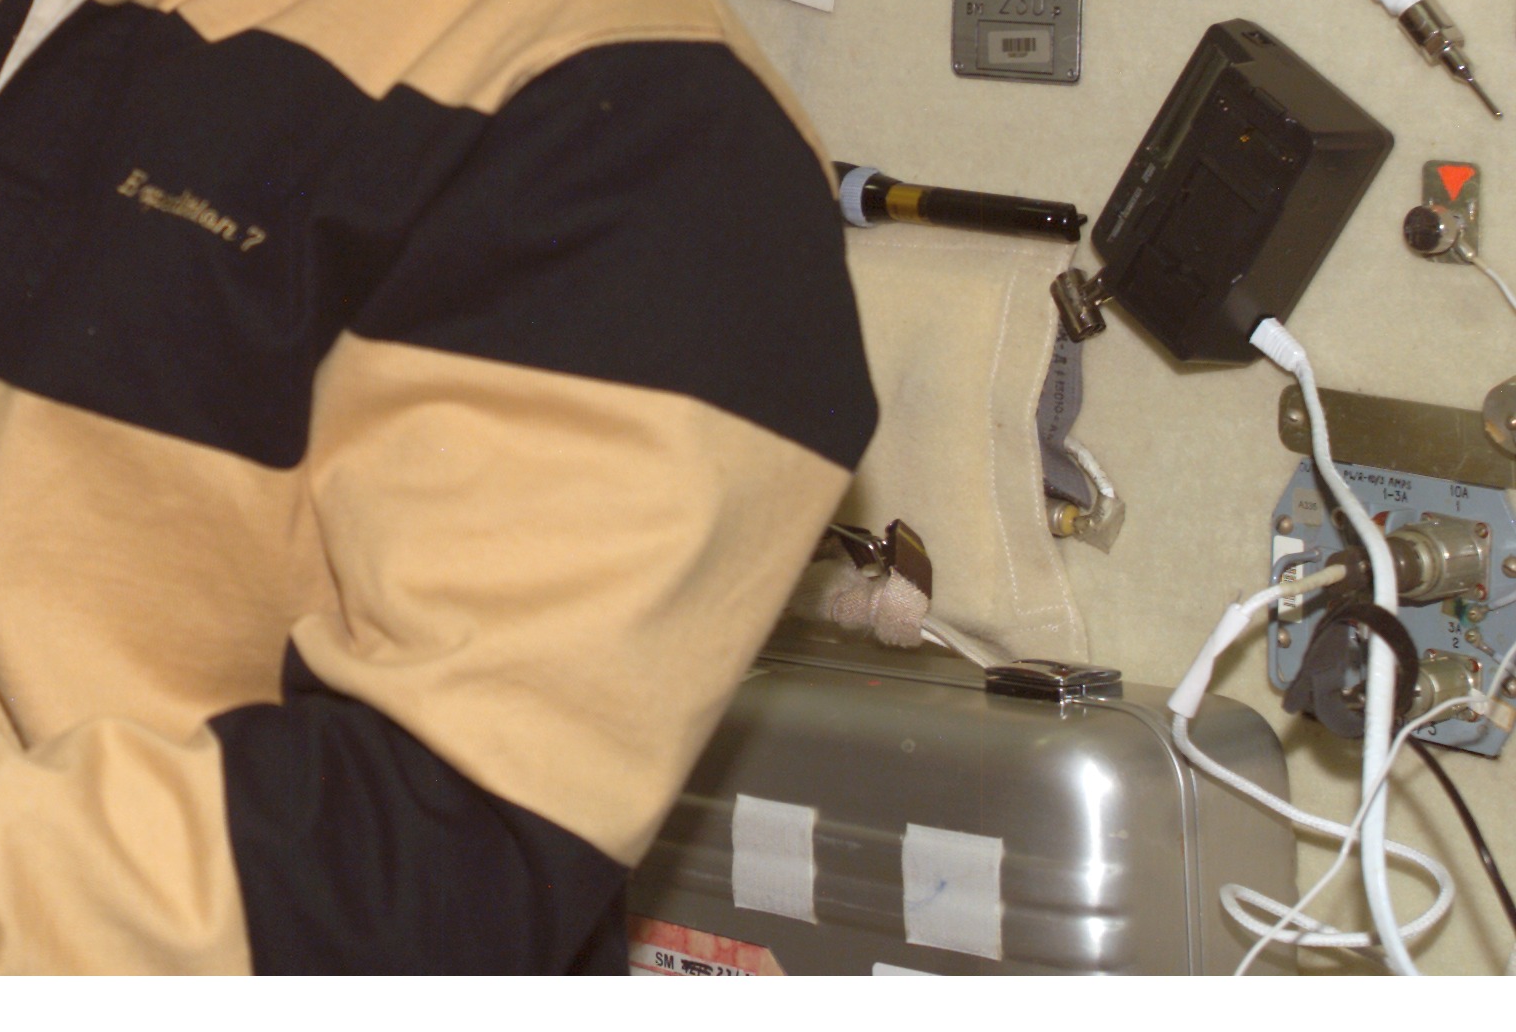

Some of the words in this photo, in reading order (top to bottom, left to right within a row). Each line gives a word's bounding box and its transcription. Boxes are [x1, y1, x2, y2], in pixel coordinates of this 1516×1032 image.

[240, 225, 266, 252] 7
[1388, 477, 1413, 490] AMPS
[1449, 484, 1470, 499] 10A
[1447, 621, 1462, 635] 3A
[1452, 637, 1460, 649] 2
[655, 951, 675, 970] SM
